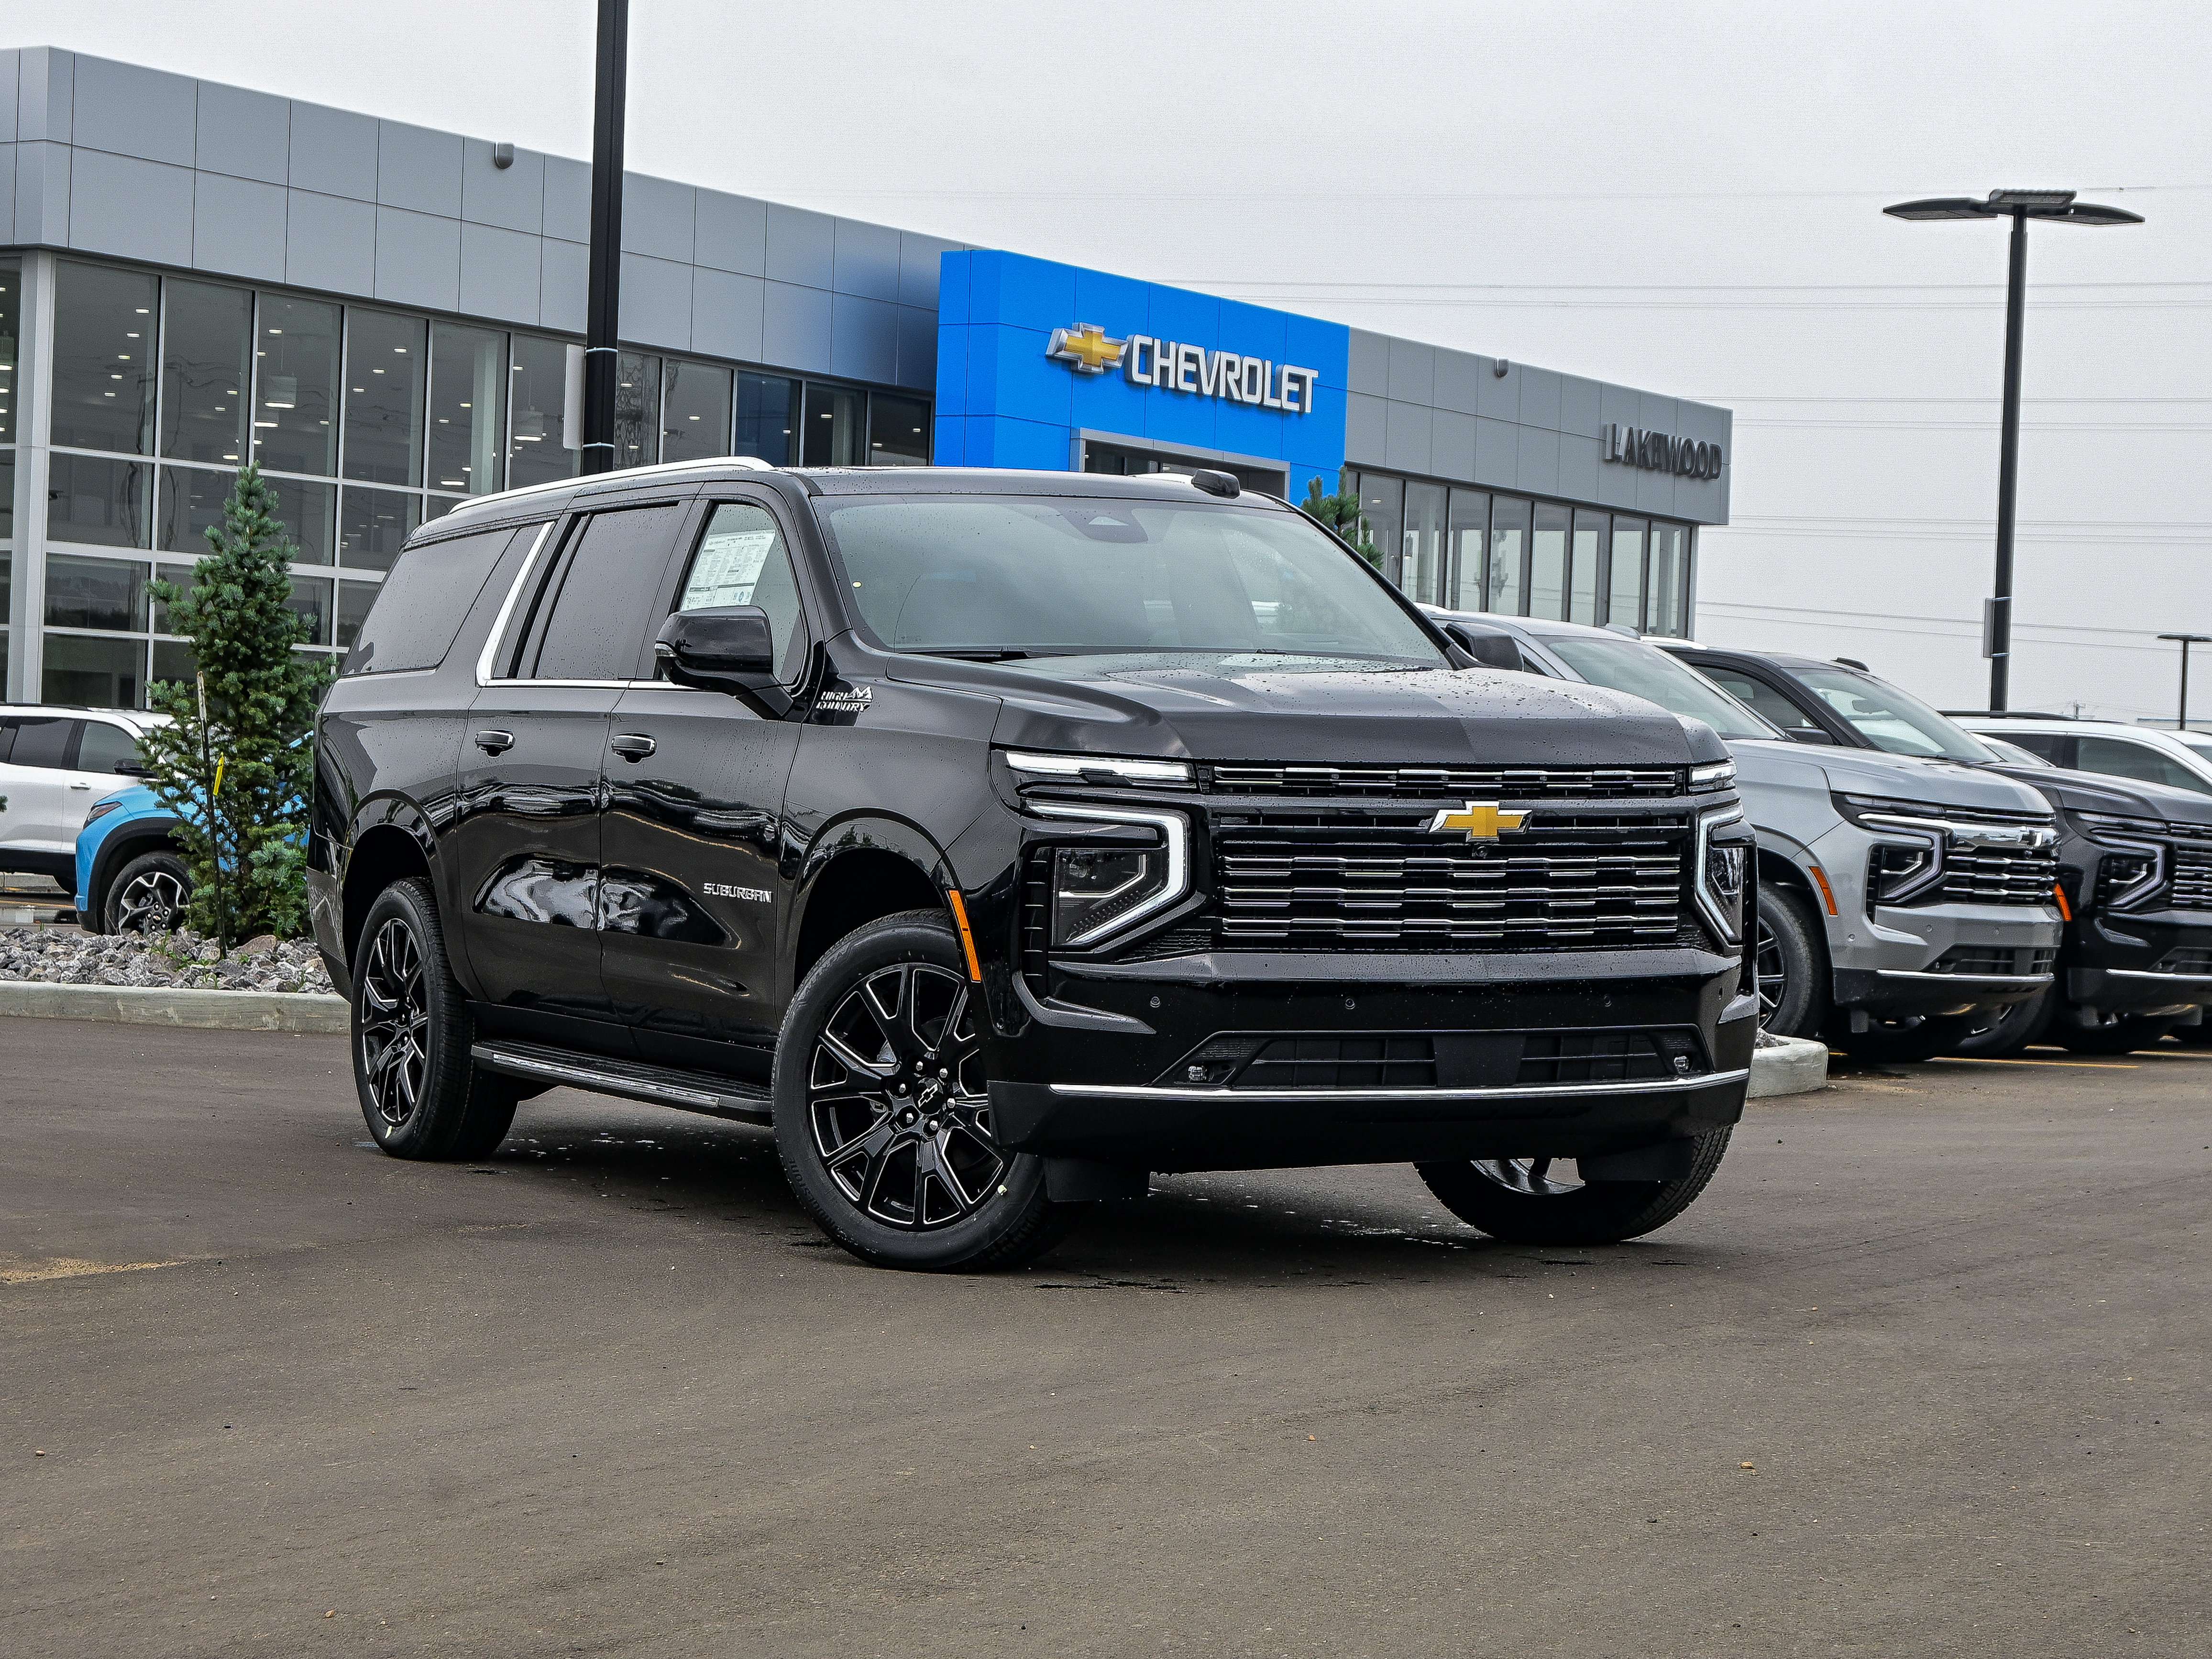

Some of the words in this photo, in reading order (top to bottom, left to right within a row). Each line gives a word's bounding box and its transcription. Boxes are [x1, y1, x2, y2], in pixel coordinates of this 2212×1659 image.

[1127, 334, 1319, 413] CHEVROLET
[1605, 423, 1722, 480] LAKEWOOD
[703, 883, 772, 903] SUBURBAN
[789, 1157, 841, 1232] RIDGESTONE
